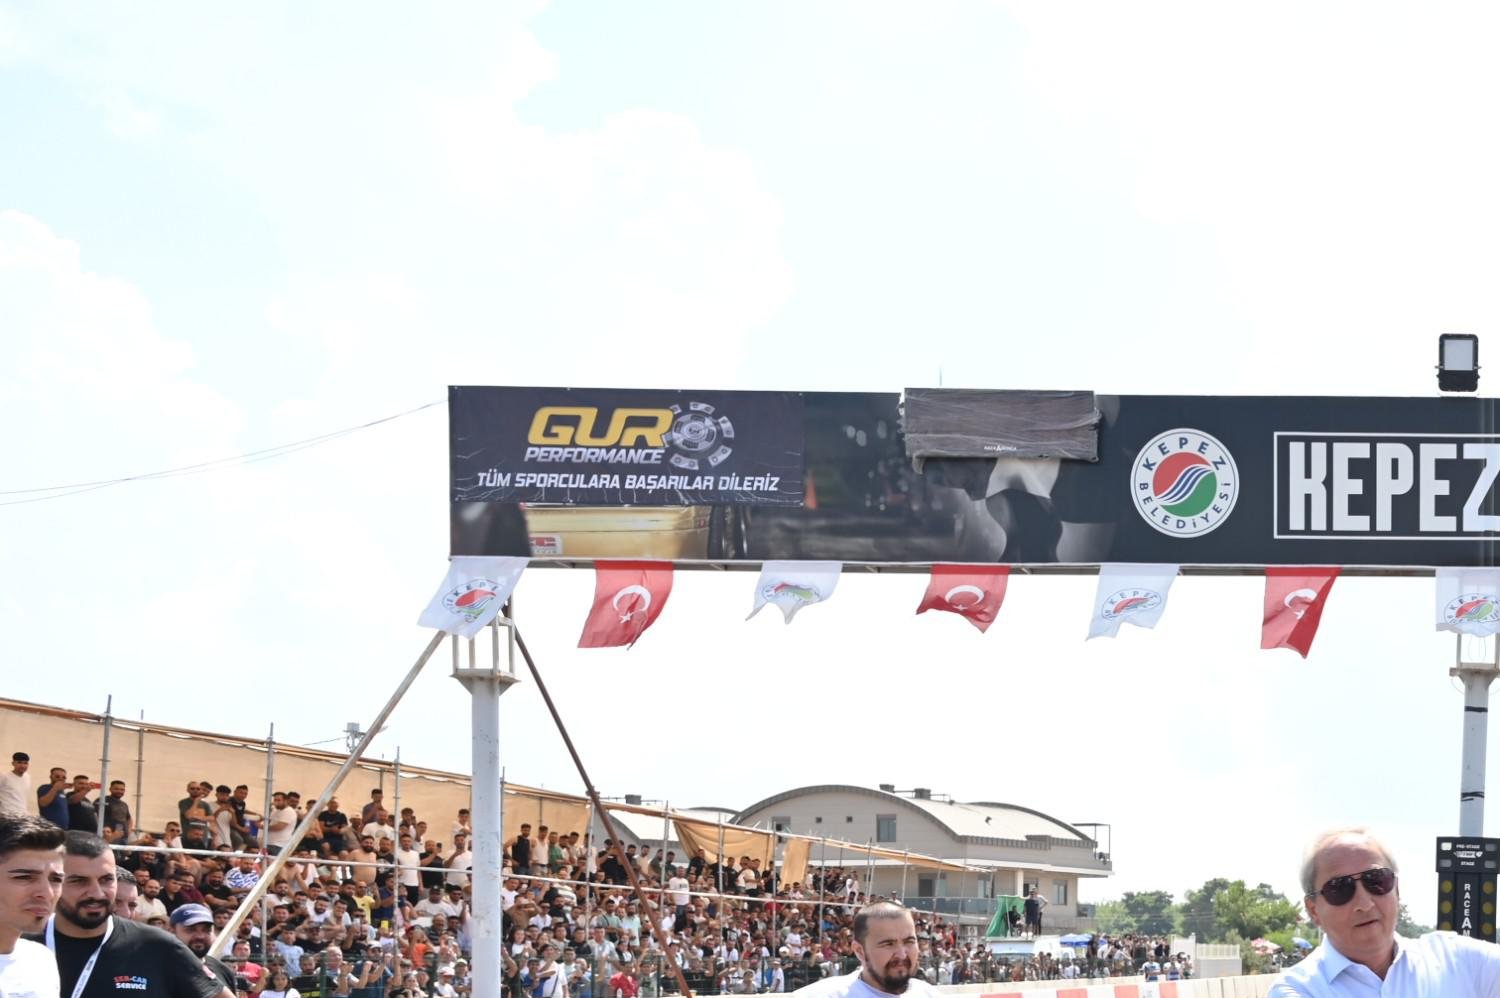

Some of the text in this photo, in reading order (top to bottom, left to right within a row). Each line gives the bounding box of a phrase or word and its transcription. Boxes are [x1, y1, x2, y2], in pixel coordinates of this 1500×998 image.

[524, 447, 666, 464] PERFORMANCE
[1142, 437, 1227, 471] KEPEZ
[477, 468, 780, 493] TÜM SPORCULARA BAŞARILAR DİLERİZ
[1461, 883, 1473, 937] RACEAM
